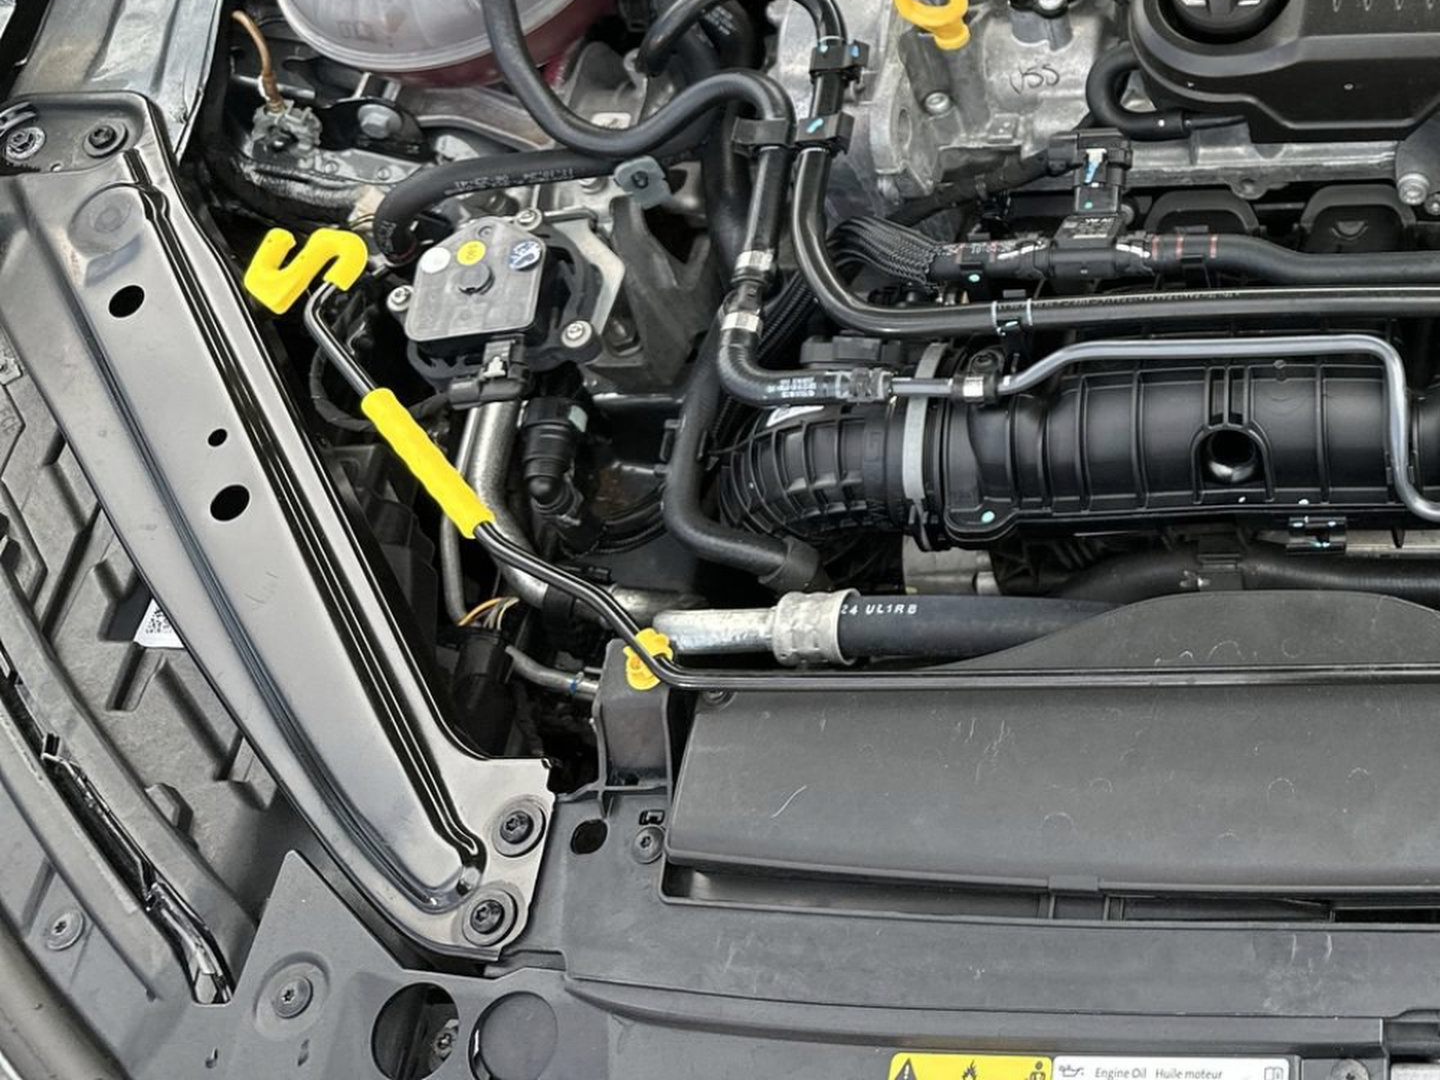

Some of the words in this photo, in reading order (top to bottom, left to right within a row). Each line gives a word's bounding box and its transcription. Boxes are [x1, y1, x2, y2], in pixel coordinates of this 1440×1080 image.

[1095, 1067, 1130, 1080] Engine
[1131, 1067, 1147, 1079] Oil
[1155, 1069, 1183, 1080] Huile
[1184, 1070, 1223, 1080] moteur
